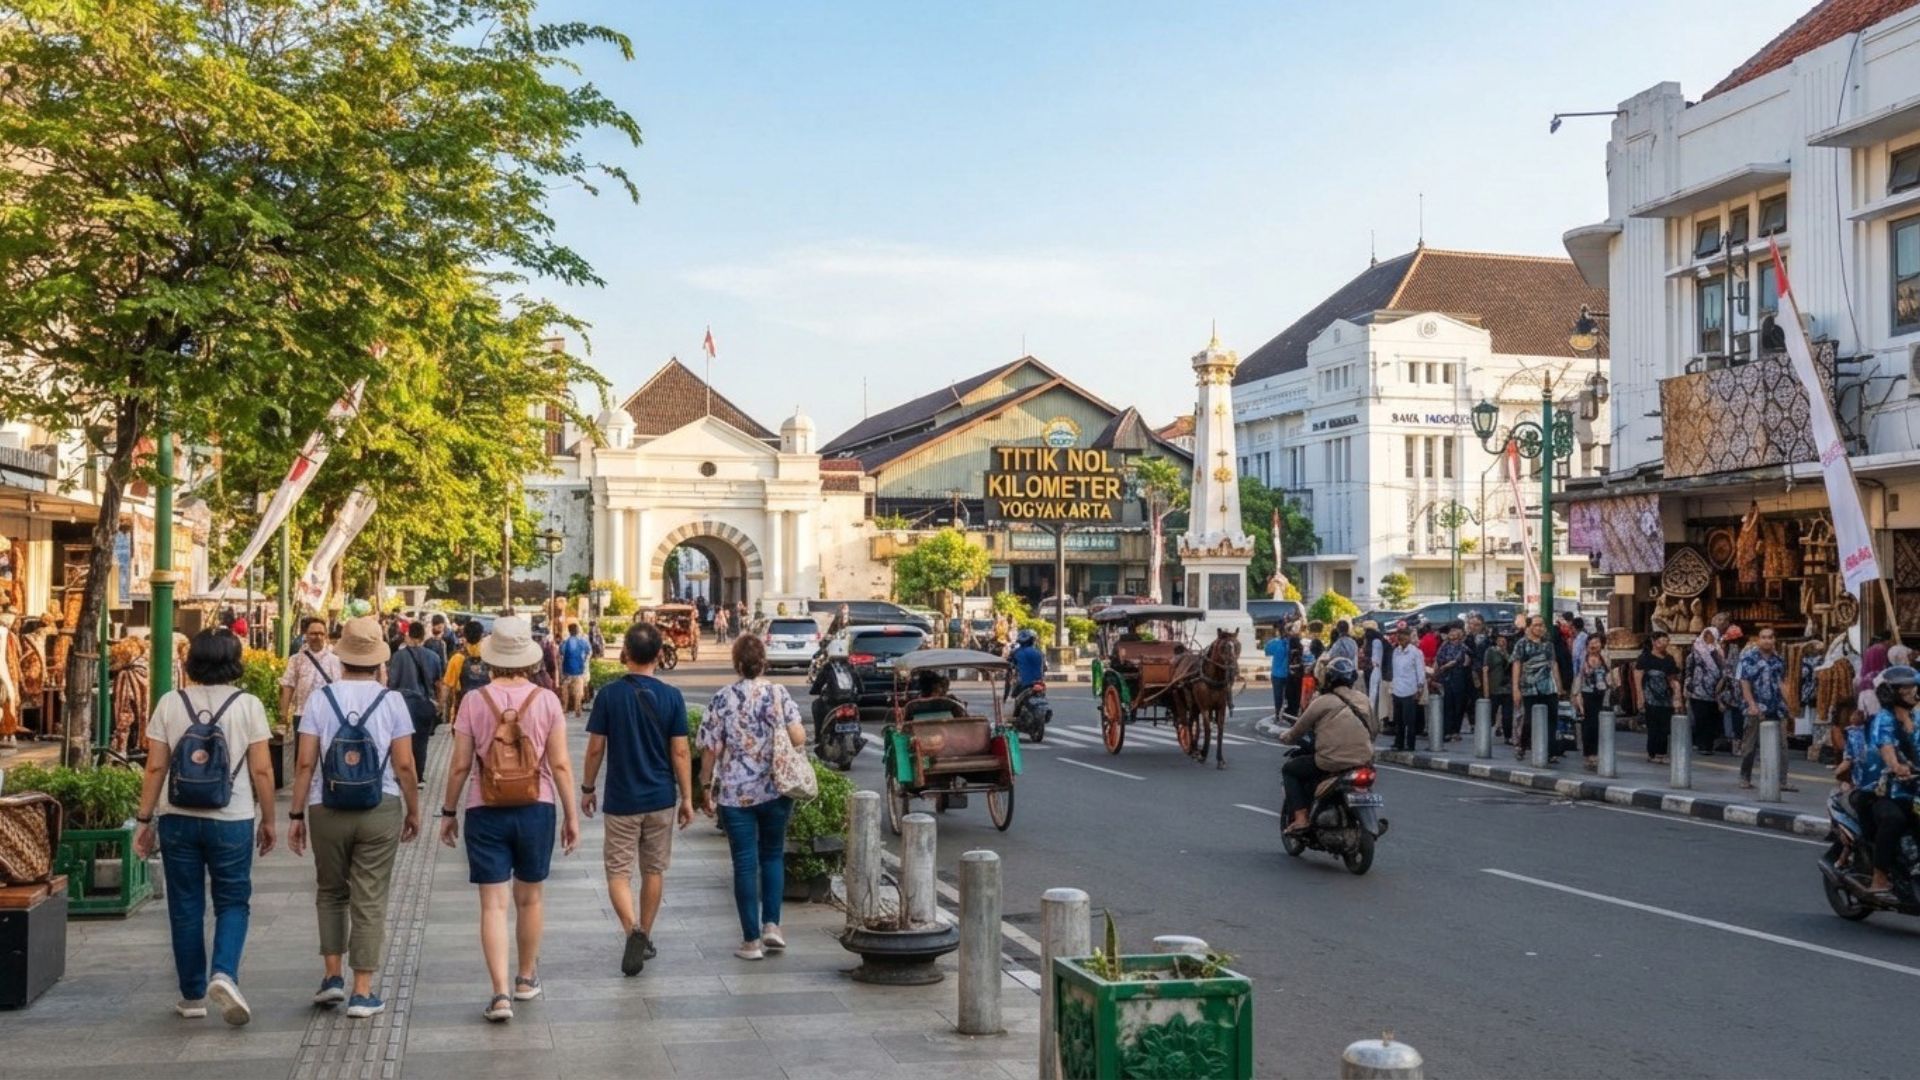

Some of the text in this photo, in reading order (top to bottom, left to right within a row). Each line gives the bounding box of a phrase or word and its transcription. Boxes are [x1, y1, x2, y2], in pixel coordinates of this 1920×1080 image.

[998, 448, 1115, 473] TITIK NOL
[988, 474, 1121, 500] KILOMETER
[999, 501, 1112, 519] YOGYAKARTA
